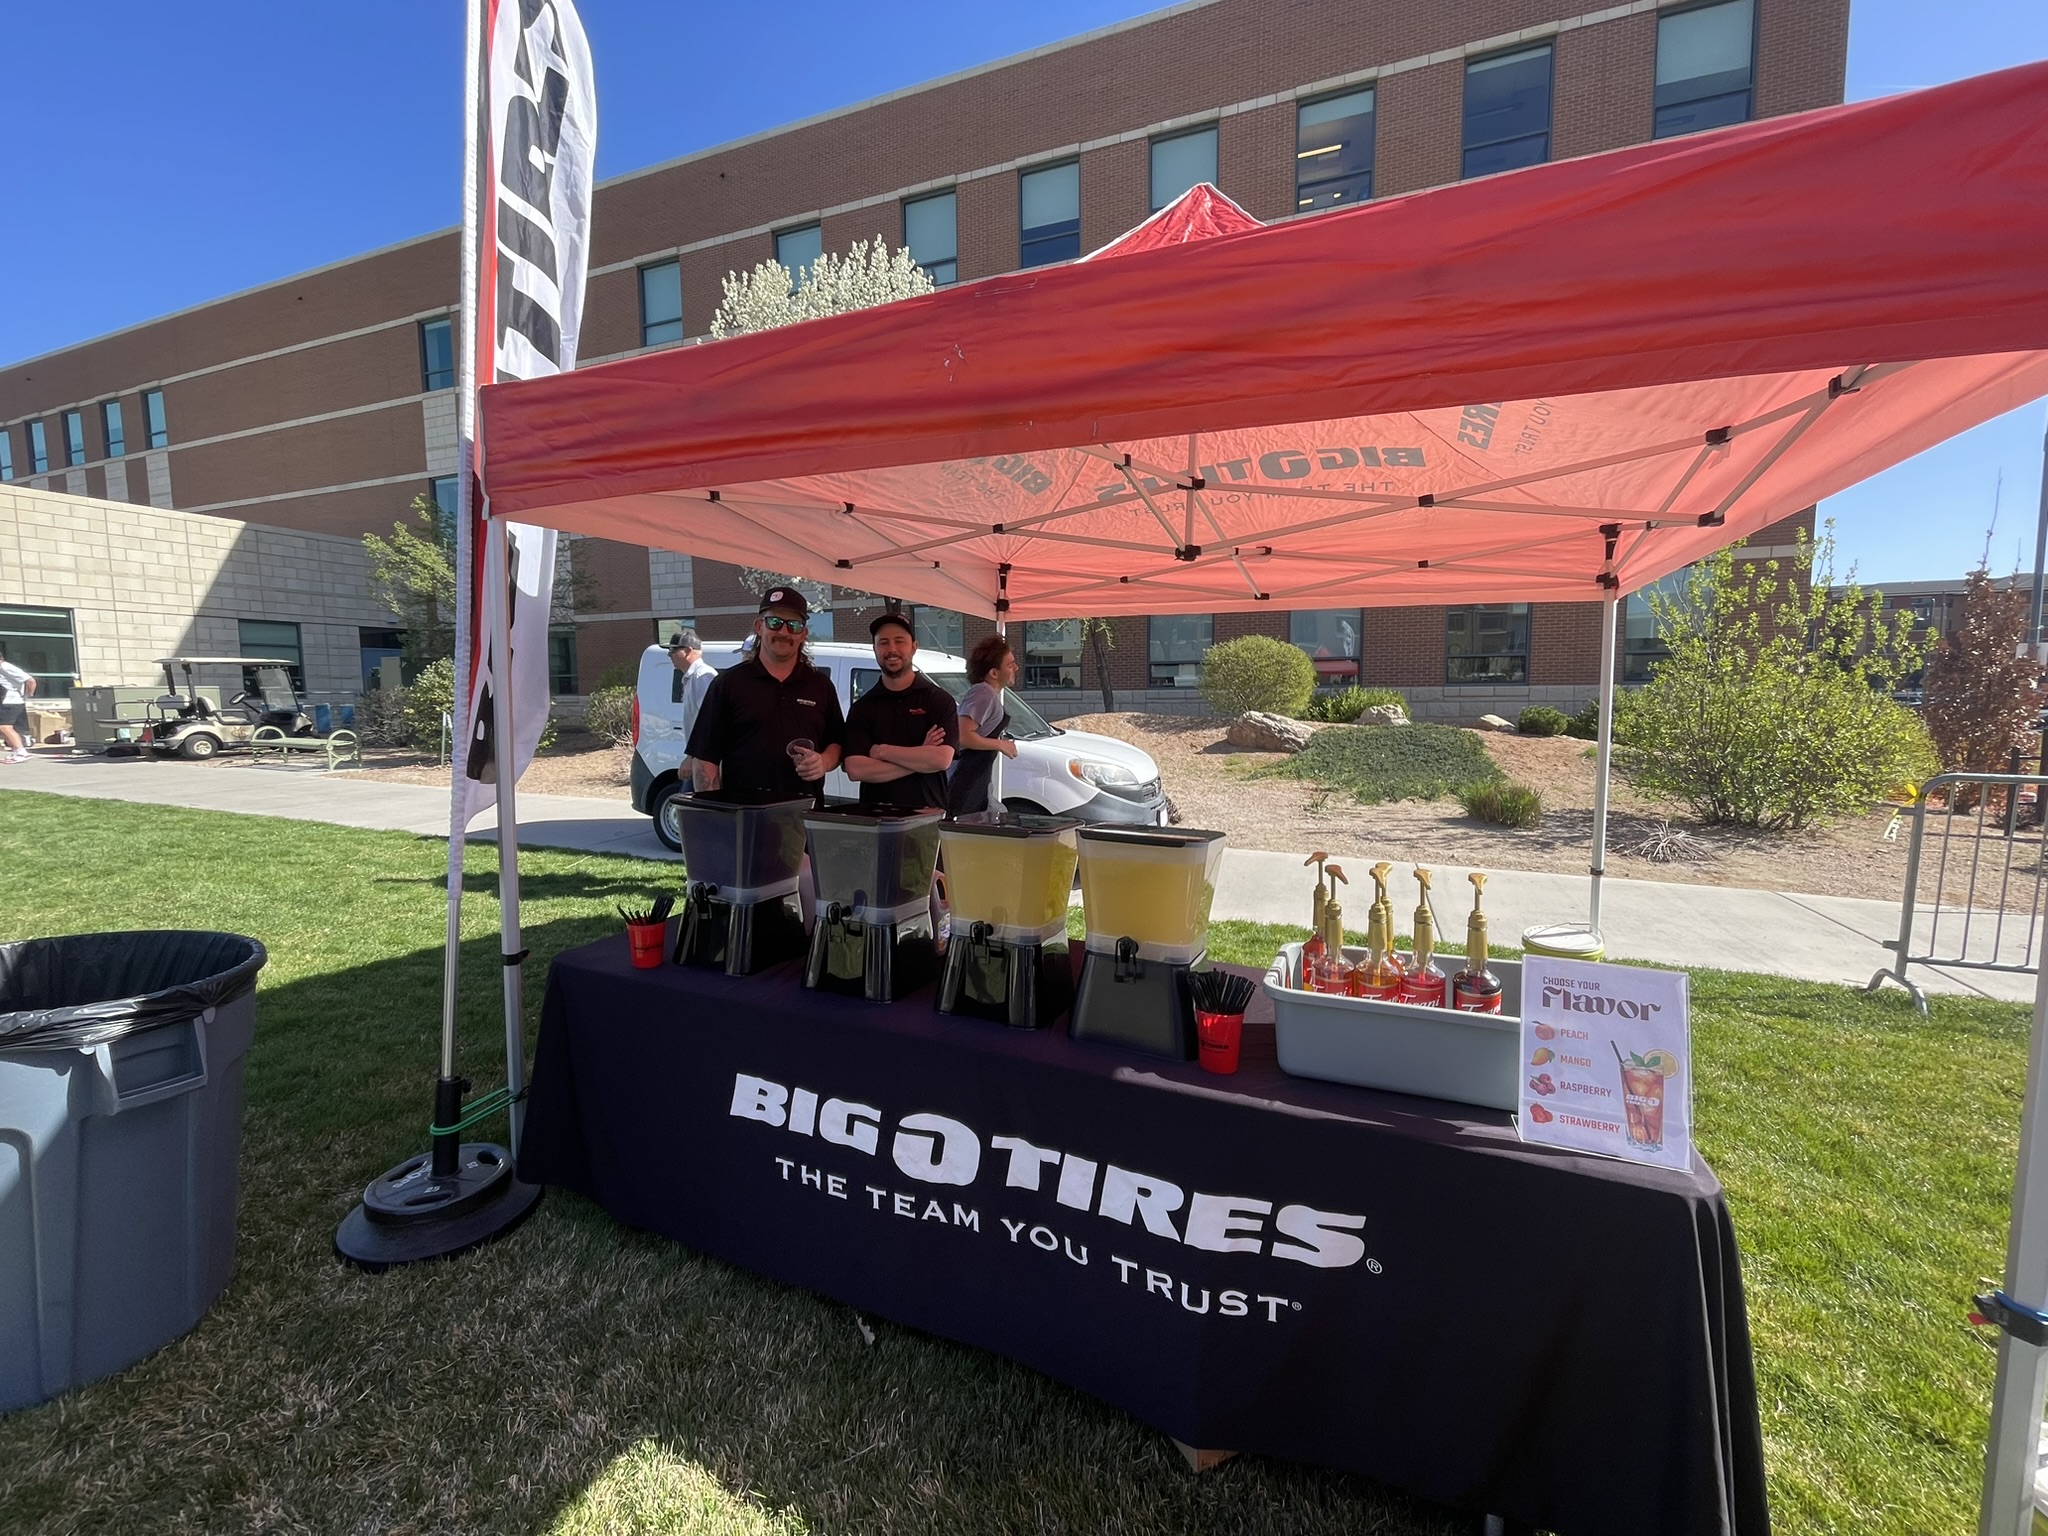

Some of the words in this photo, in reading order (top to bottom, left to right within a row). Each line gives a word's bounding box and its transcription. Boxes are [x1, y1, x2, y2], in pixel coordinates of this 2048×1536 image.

[1543, 976, 1576, 988] CHOOSE
[1577, 980, 1601, 991] YOUR
[1542, 986, 1662, 1021] Flavor
[1560, 1028, 1589, 1041] PEACH
[1560, 1054, 1592, 1068] MANGO
[1560, 1081, 1612, 1098] RASPBERRY
[729, 1072, 881, 1156] BIG
[1559, 1114, 1621, 1134] STRAWBERRY
[775, 1156, 848, 1201] THE
[866, 1185, 981, 1233] TEAM
[1000, 1217, 1090, 1266] YOU
